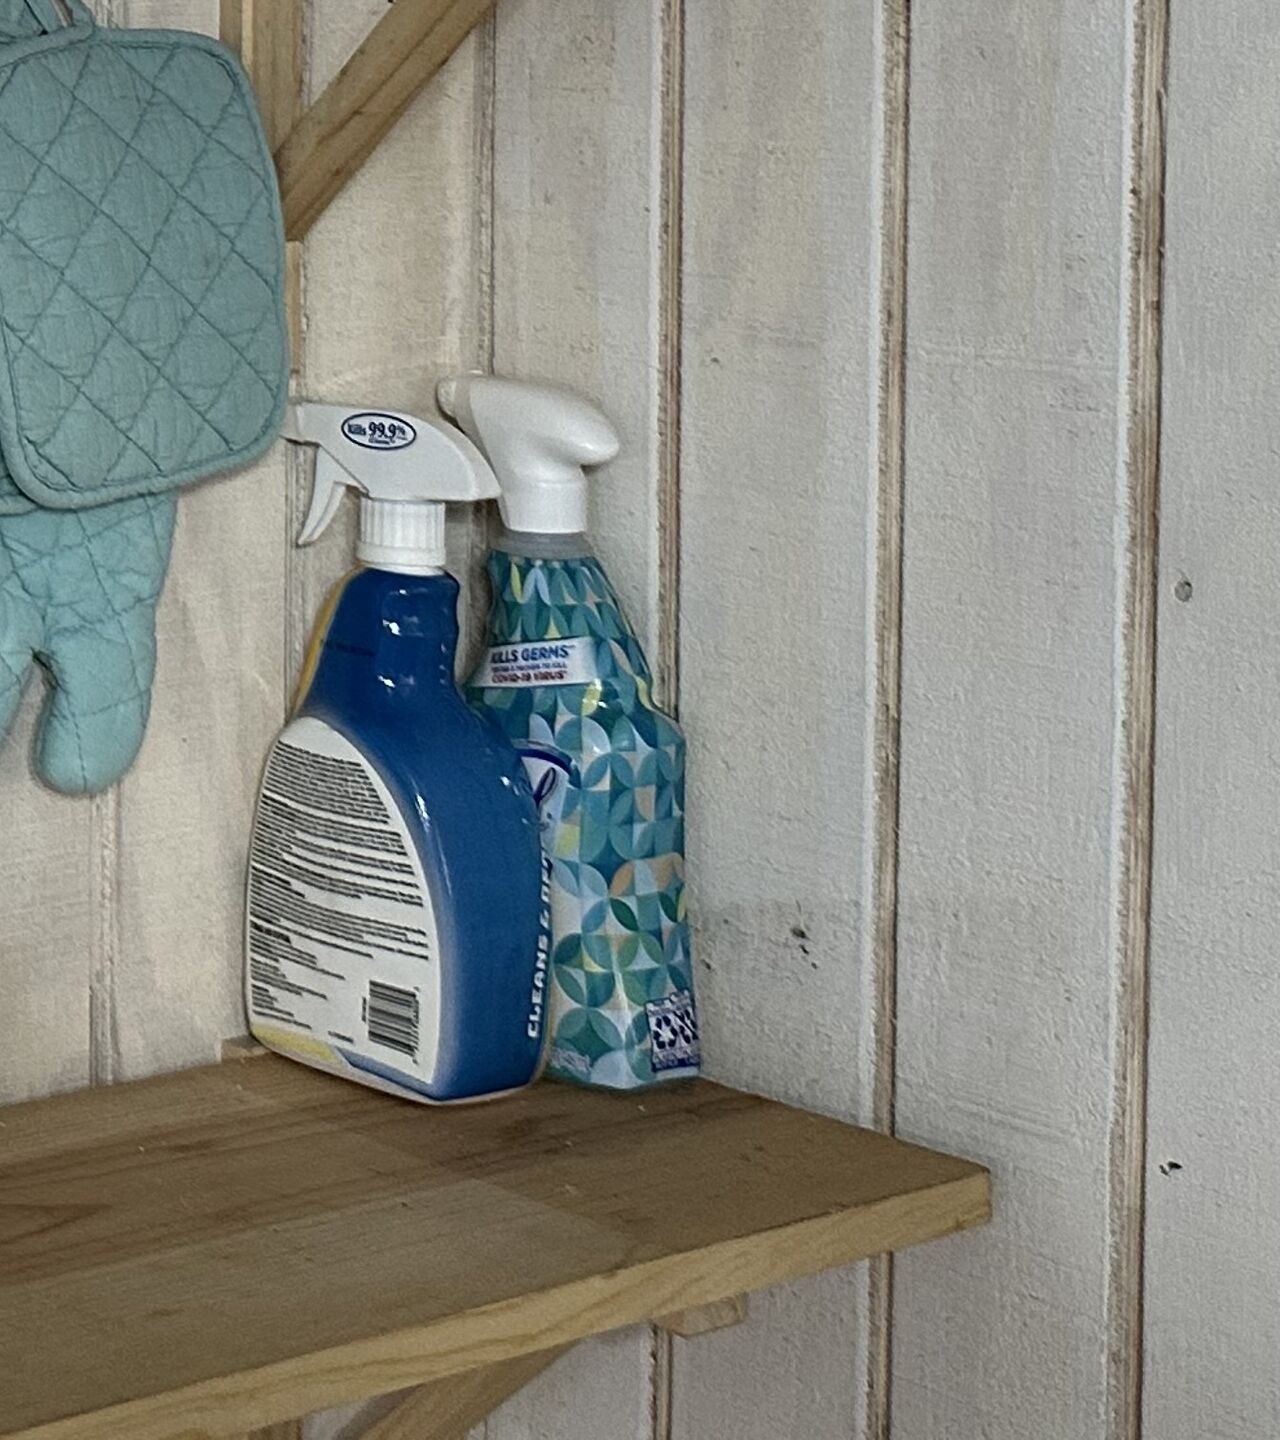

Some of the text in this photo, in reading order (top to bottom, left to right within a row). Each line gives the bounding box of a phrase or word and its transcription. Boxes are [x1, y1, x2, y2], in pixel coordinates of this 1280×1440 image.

[368, 421, 407, 440] 99.9%
[491, 646, 569, 664] KILLS GERMS
[492, 672, 531, 684] COVID-19
[527, 935, 550, 1039] CLEANS
